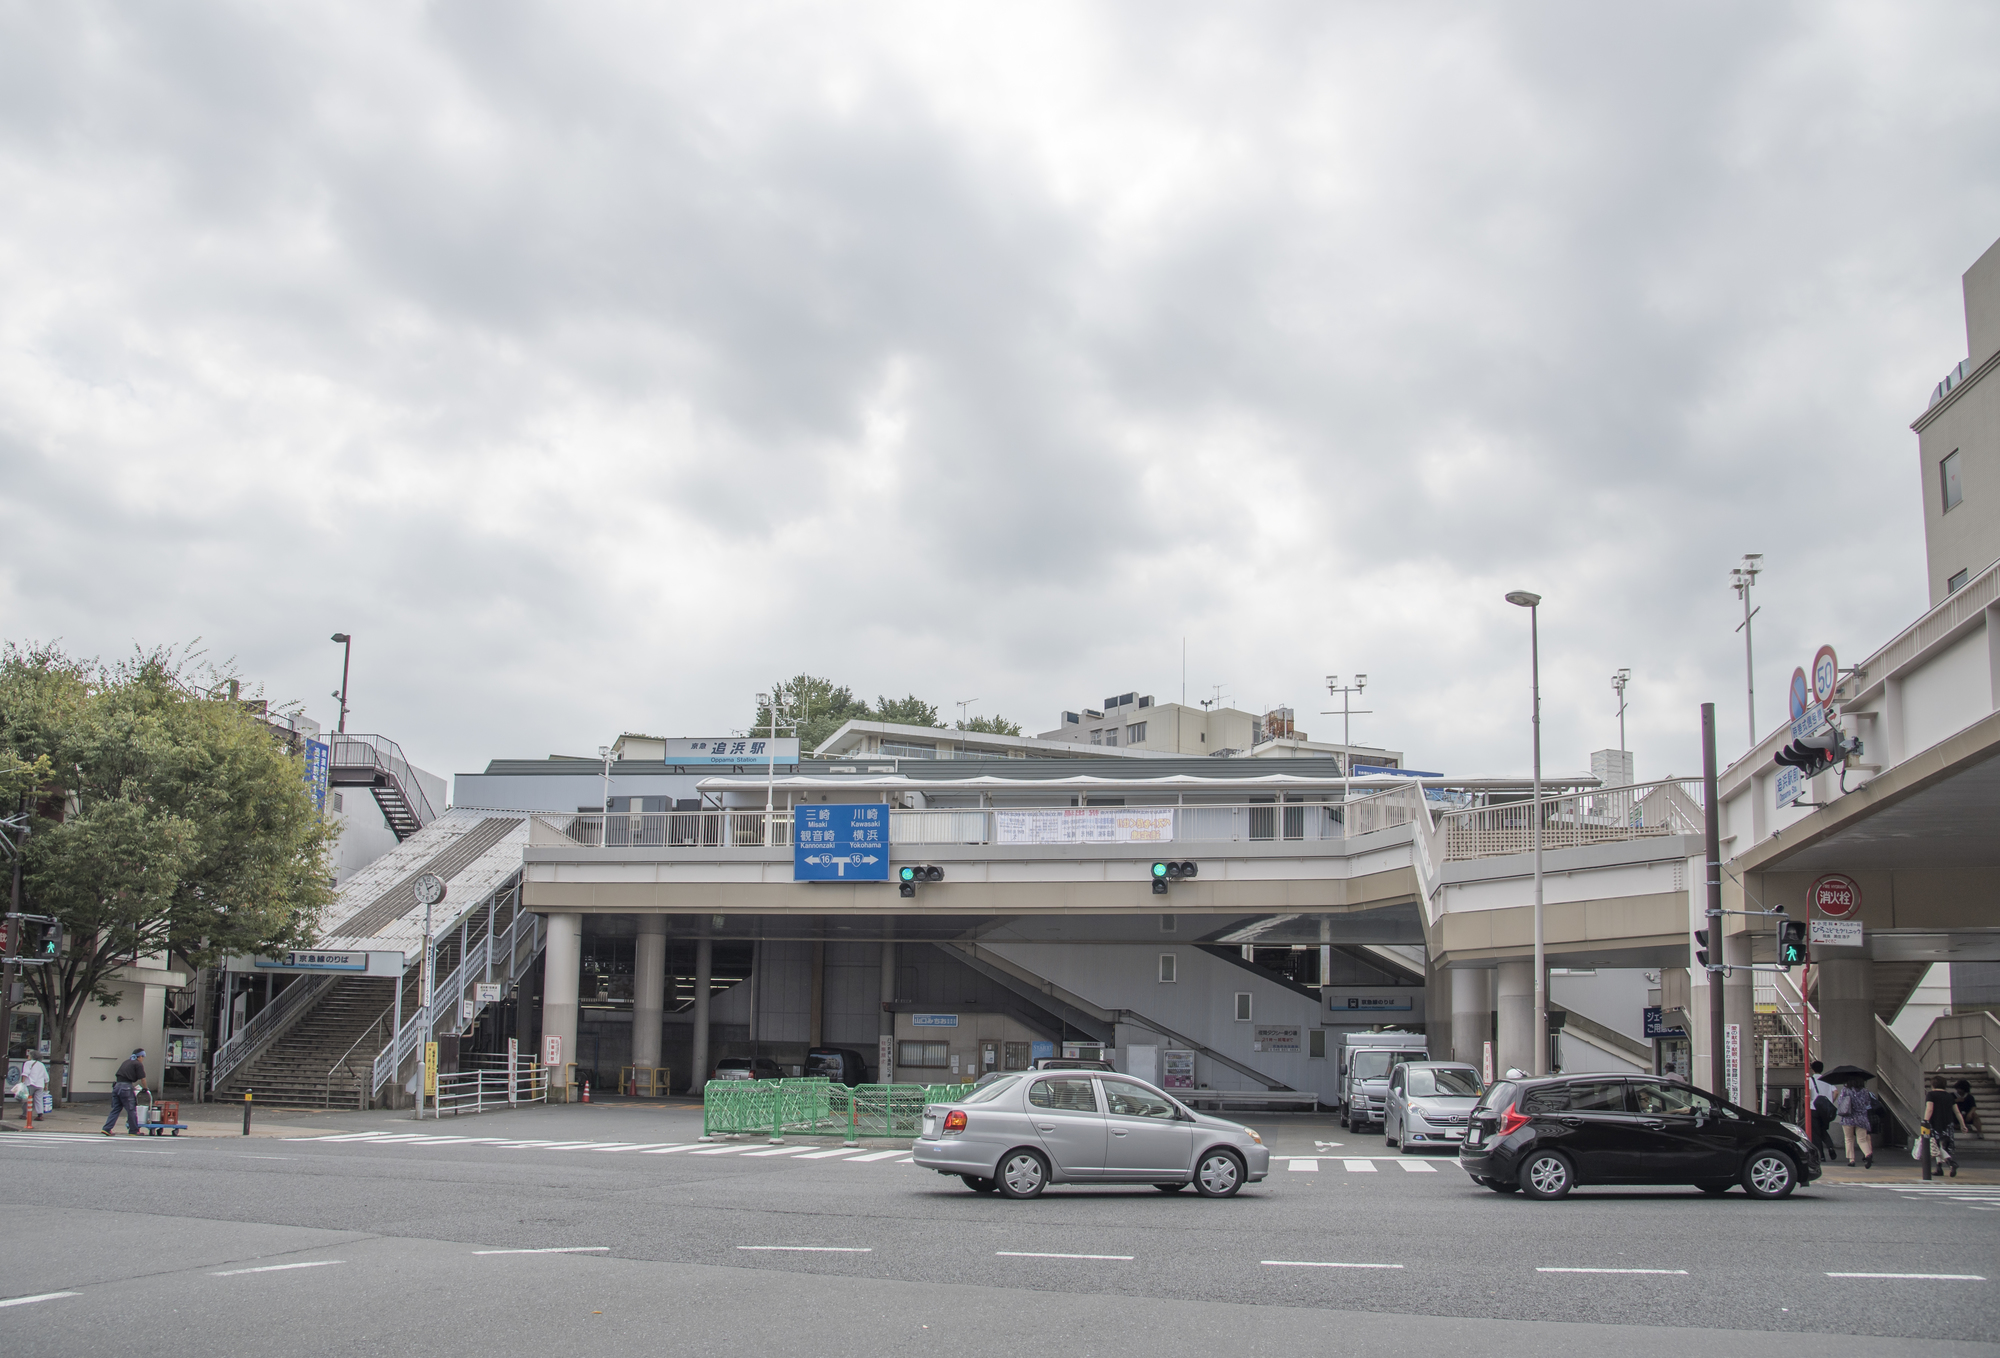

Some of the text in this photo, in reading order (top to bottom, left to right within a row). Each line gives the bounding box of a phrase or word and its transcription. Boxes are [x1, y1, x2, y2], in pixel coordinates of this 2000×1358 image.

[1817, 661, 1833, 694] 50
[690, 741, 766, 755] 京急 追浜駅
[1777, 767, 1799, 792] 追浜駅前
[805, 808, 879, 820] 三崎 川崎
[800, 829, 879, 842] 観音崎 横浜
[821, 855, 861, 864] 16 16
[1820, 891, 1850, 905] 消火栓
[298, 954, 350, 964] 京急線のりば
